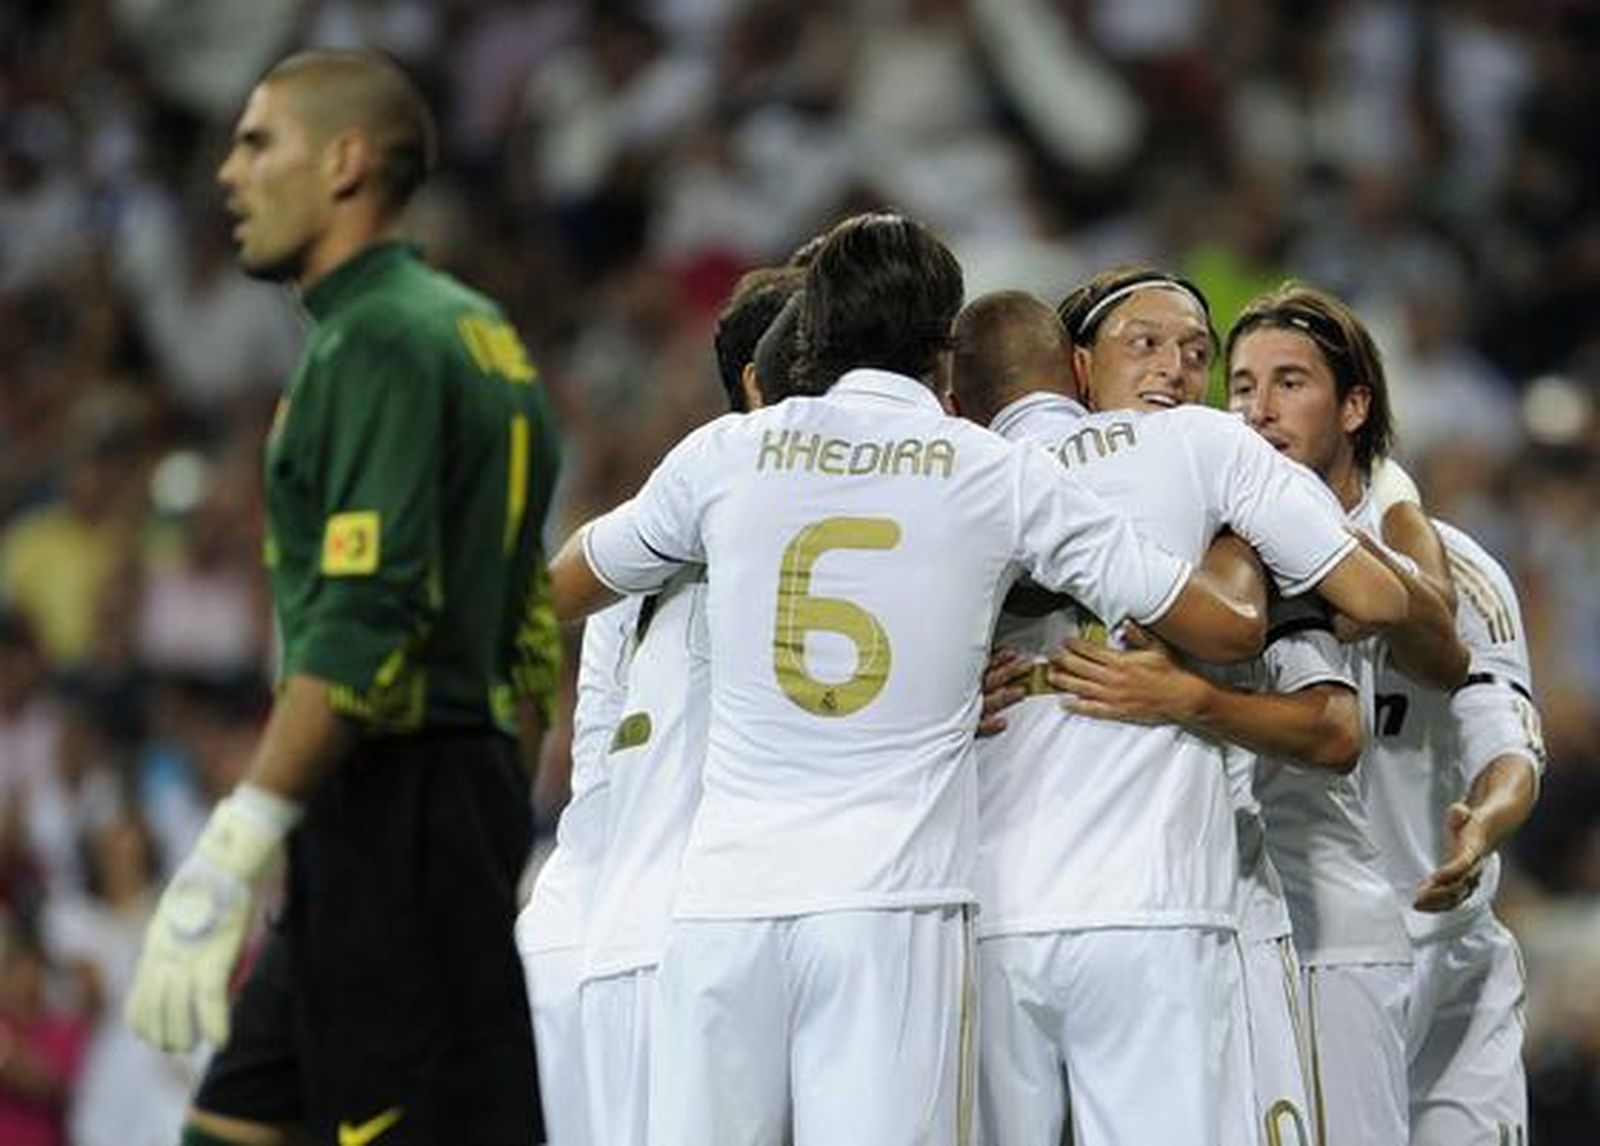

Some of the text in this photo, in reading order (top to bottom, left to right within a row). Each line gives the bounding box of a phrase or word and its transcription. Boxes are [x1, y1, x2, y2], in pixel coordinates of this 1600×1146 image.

[757, 428, 956, 479] KHEDIRA
[1046, 421, 1137, 470] MA
[773, 516, 903, 718] 6
